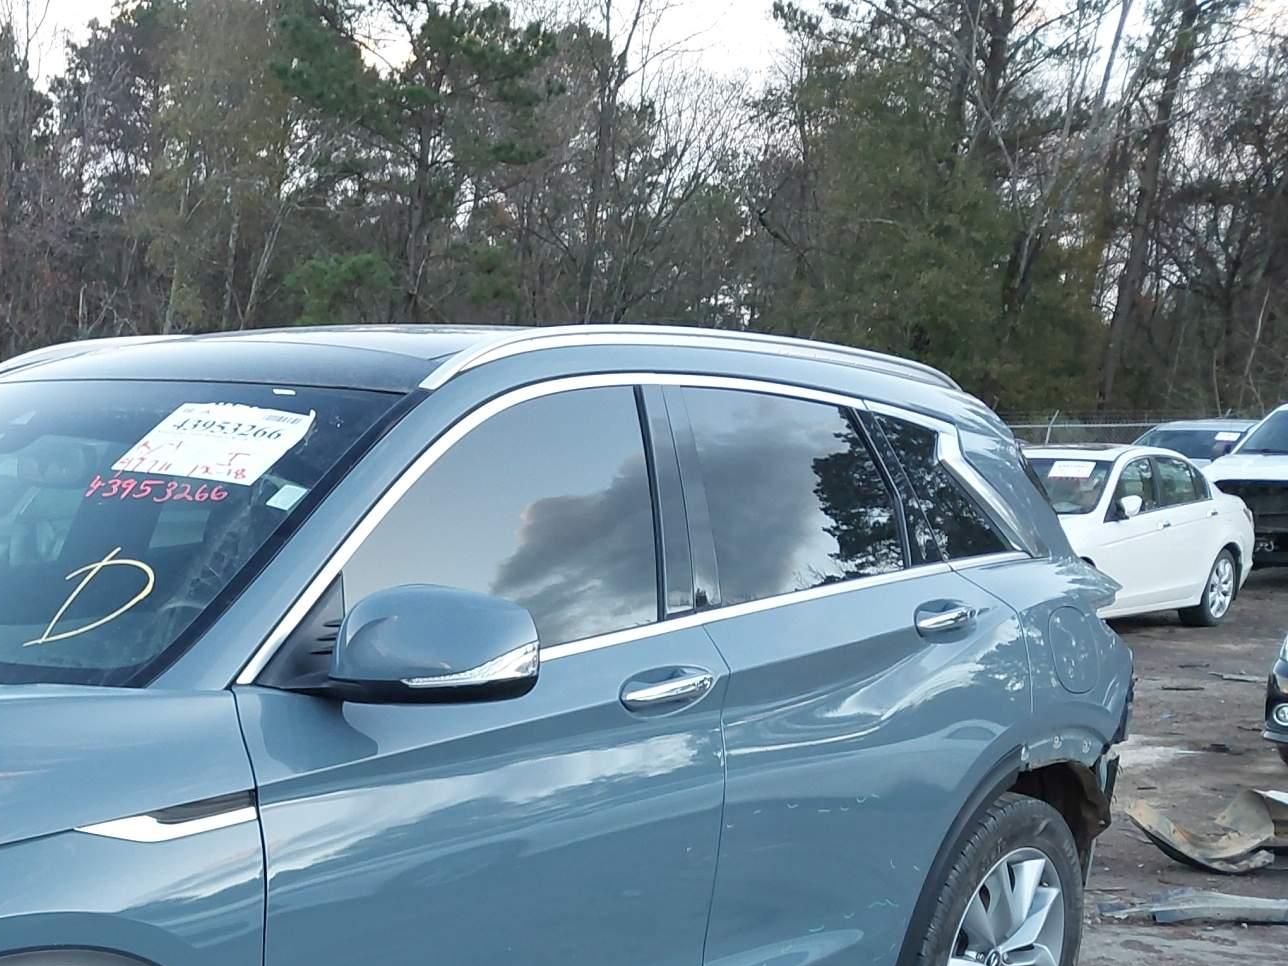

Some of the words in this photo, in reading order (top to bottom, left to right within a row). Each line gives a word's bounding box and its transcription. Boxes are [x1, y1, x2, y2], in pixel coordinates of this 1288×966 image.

[173, 417, 283, 441] 43953266
[86, 475, 228, 502] 43953266
[22, 546, 155, 647] D
